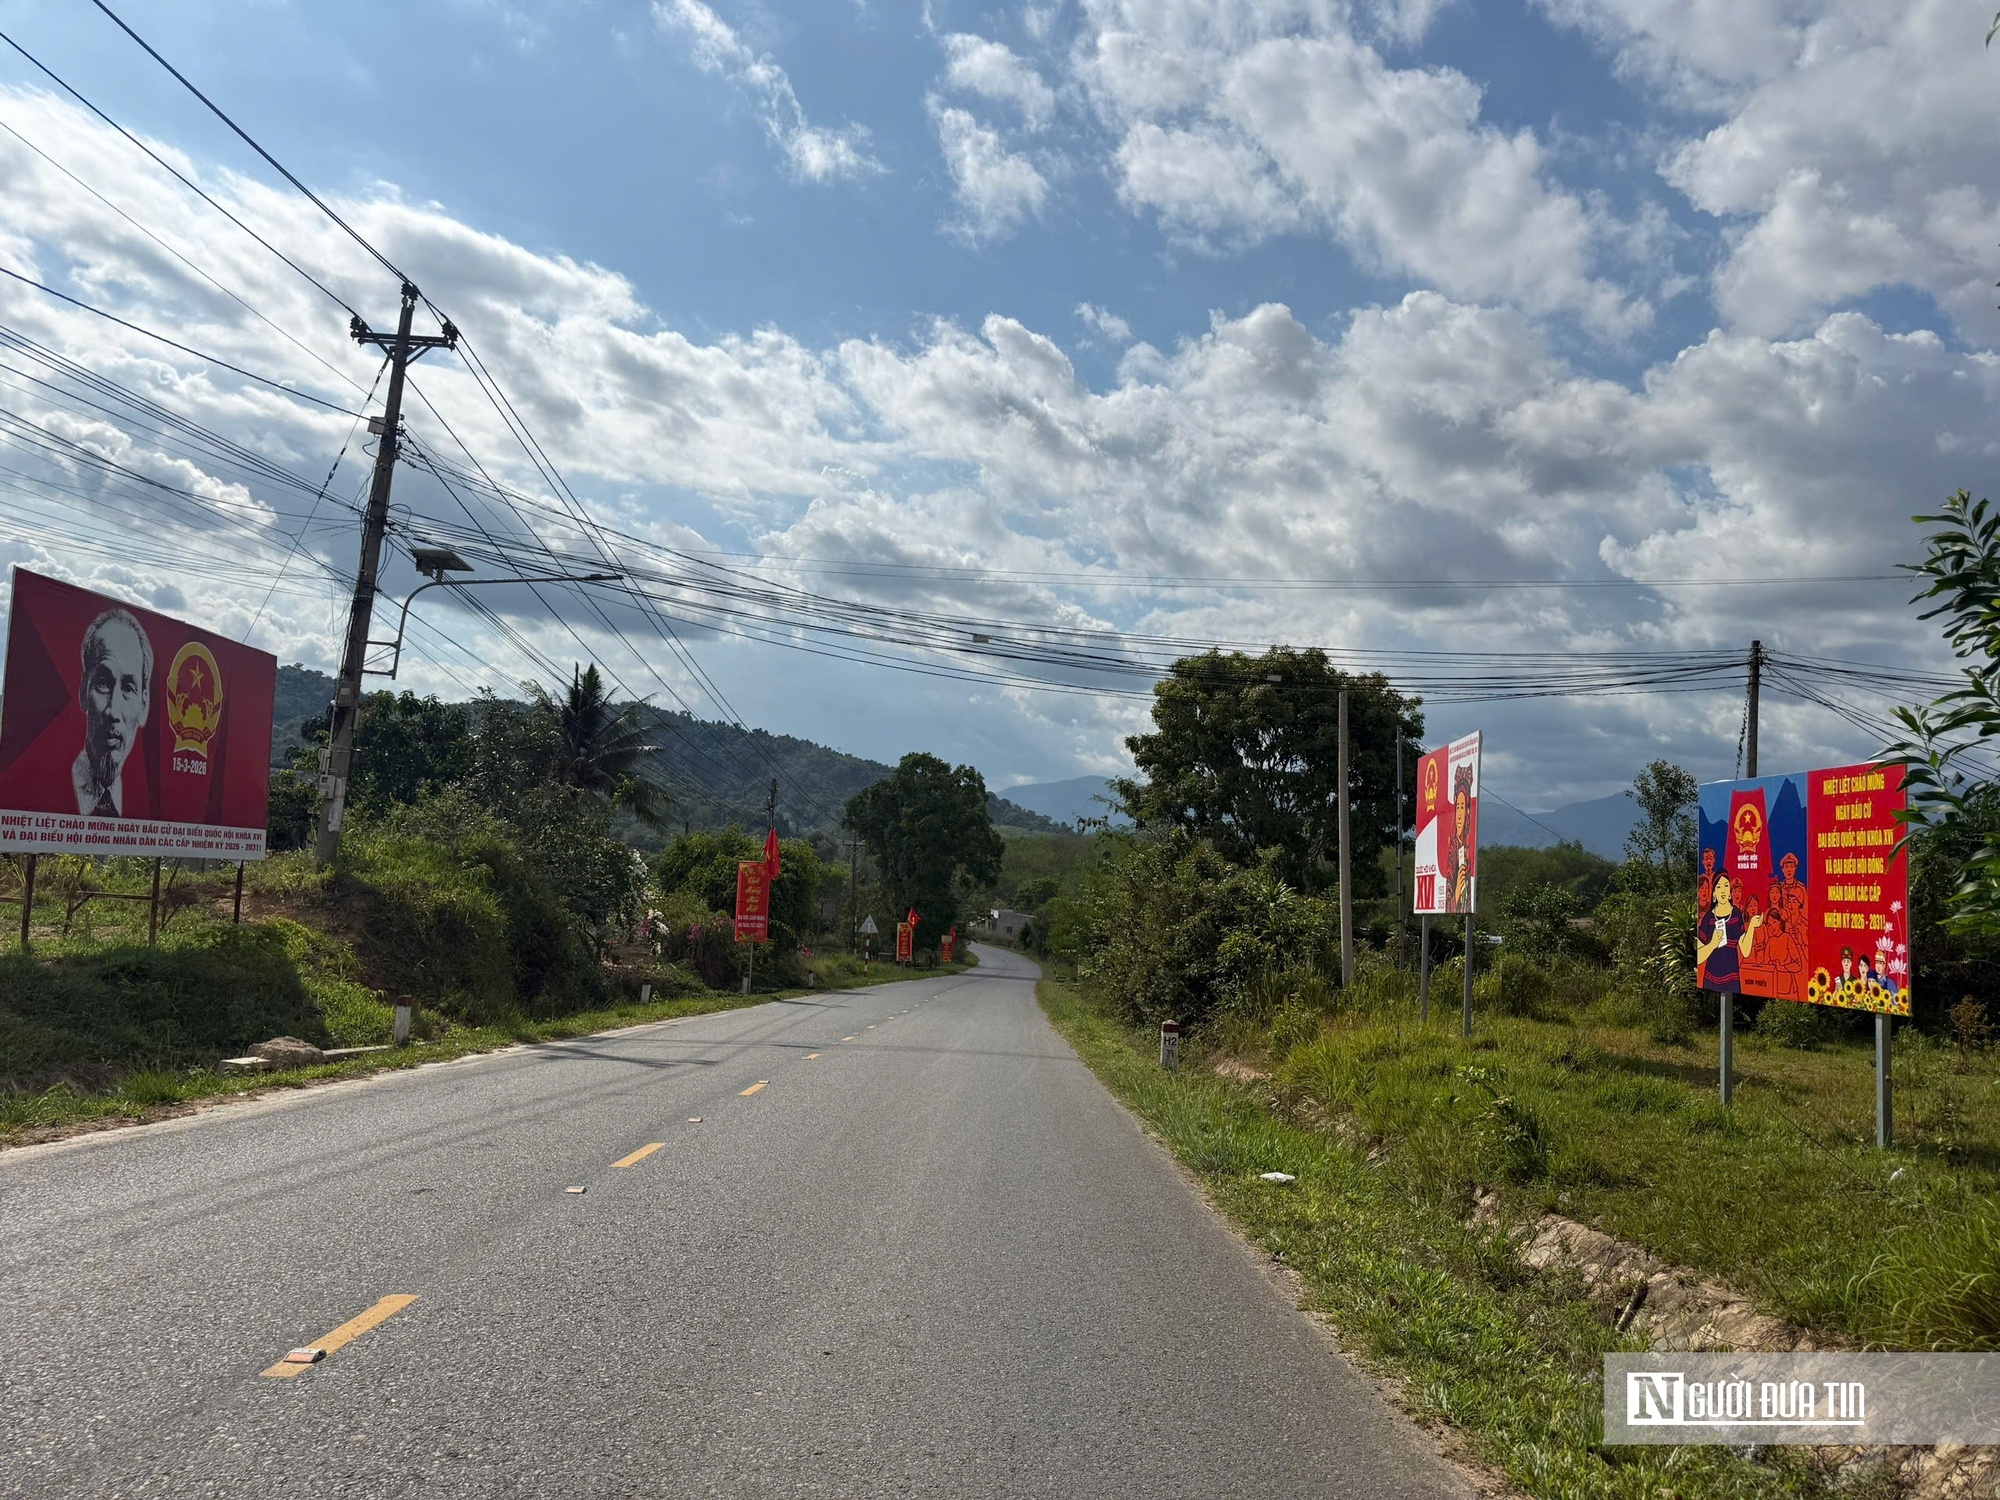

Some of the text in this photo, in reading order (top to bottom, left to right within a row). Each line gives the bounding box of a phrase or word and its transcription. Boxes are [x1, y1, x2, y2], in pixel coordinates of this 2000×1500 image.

[173, 757, 207, 775] 15-3-2026
[1839, 775, 1850, 796] LIỆT
[1, 814, 33, 828] NHIỆT
[35, 816, 57, 830] LIỆT
[59, 818, 86, 830] CHÀO
[88, 820, 115, 832] MỪNG
[118, 822, 140, 833] NGÀY
[160, 823, 172, 834] CỬ
[172, 826, 185, 838] ĐẠI
[186, 826, 202, 837] BIỂU
[204, 827, 222, 838] QUỐC
[224, 830, 234, 840] HỘI
[234, 831, 252, 840] KHÓA
[252, 833, 262, 841] XVI
[1883, 828, 1894, 846] XVI
[2, 828, 16, 840] VÀ
[20, 830, 38, 843] ĐẠI
[40, 829, 64, 842] BIỂU
[66, 832, 82, 845] HỘI
[112, 834, 137, 846] NHÂN
[138, 836, 156, 846] DÂN
[158, 836, 174, 847] CÁC
[176, 836, 190, 848] CẤP
[192, 839, 214, 850] NHIỆM
[214, 840, 224, 850] KỲ
[224, 842, 240, 851] 2026
[1415, 874, 1436, 910] XVI
[1856, 882, 1868, 902] CÁC
[1850, 913, 1865, 930] 2026
[1164, 1036, 1177, 1046] H2
